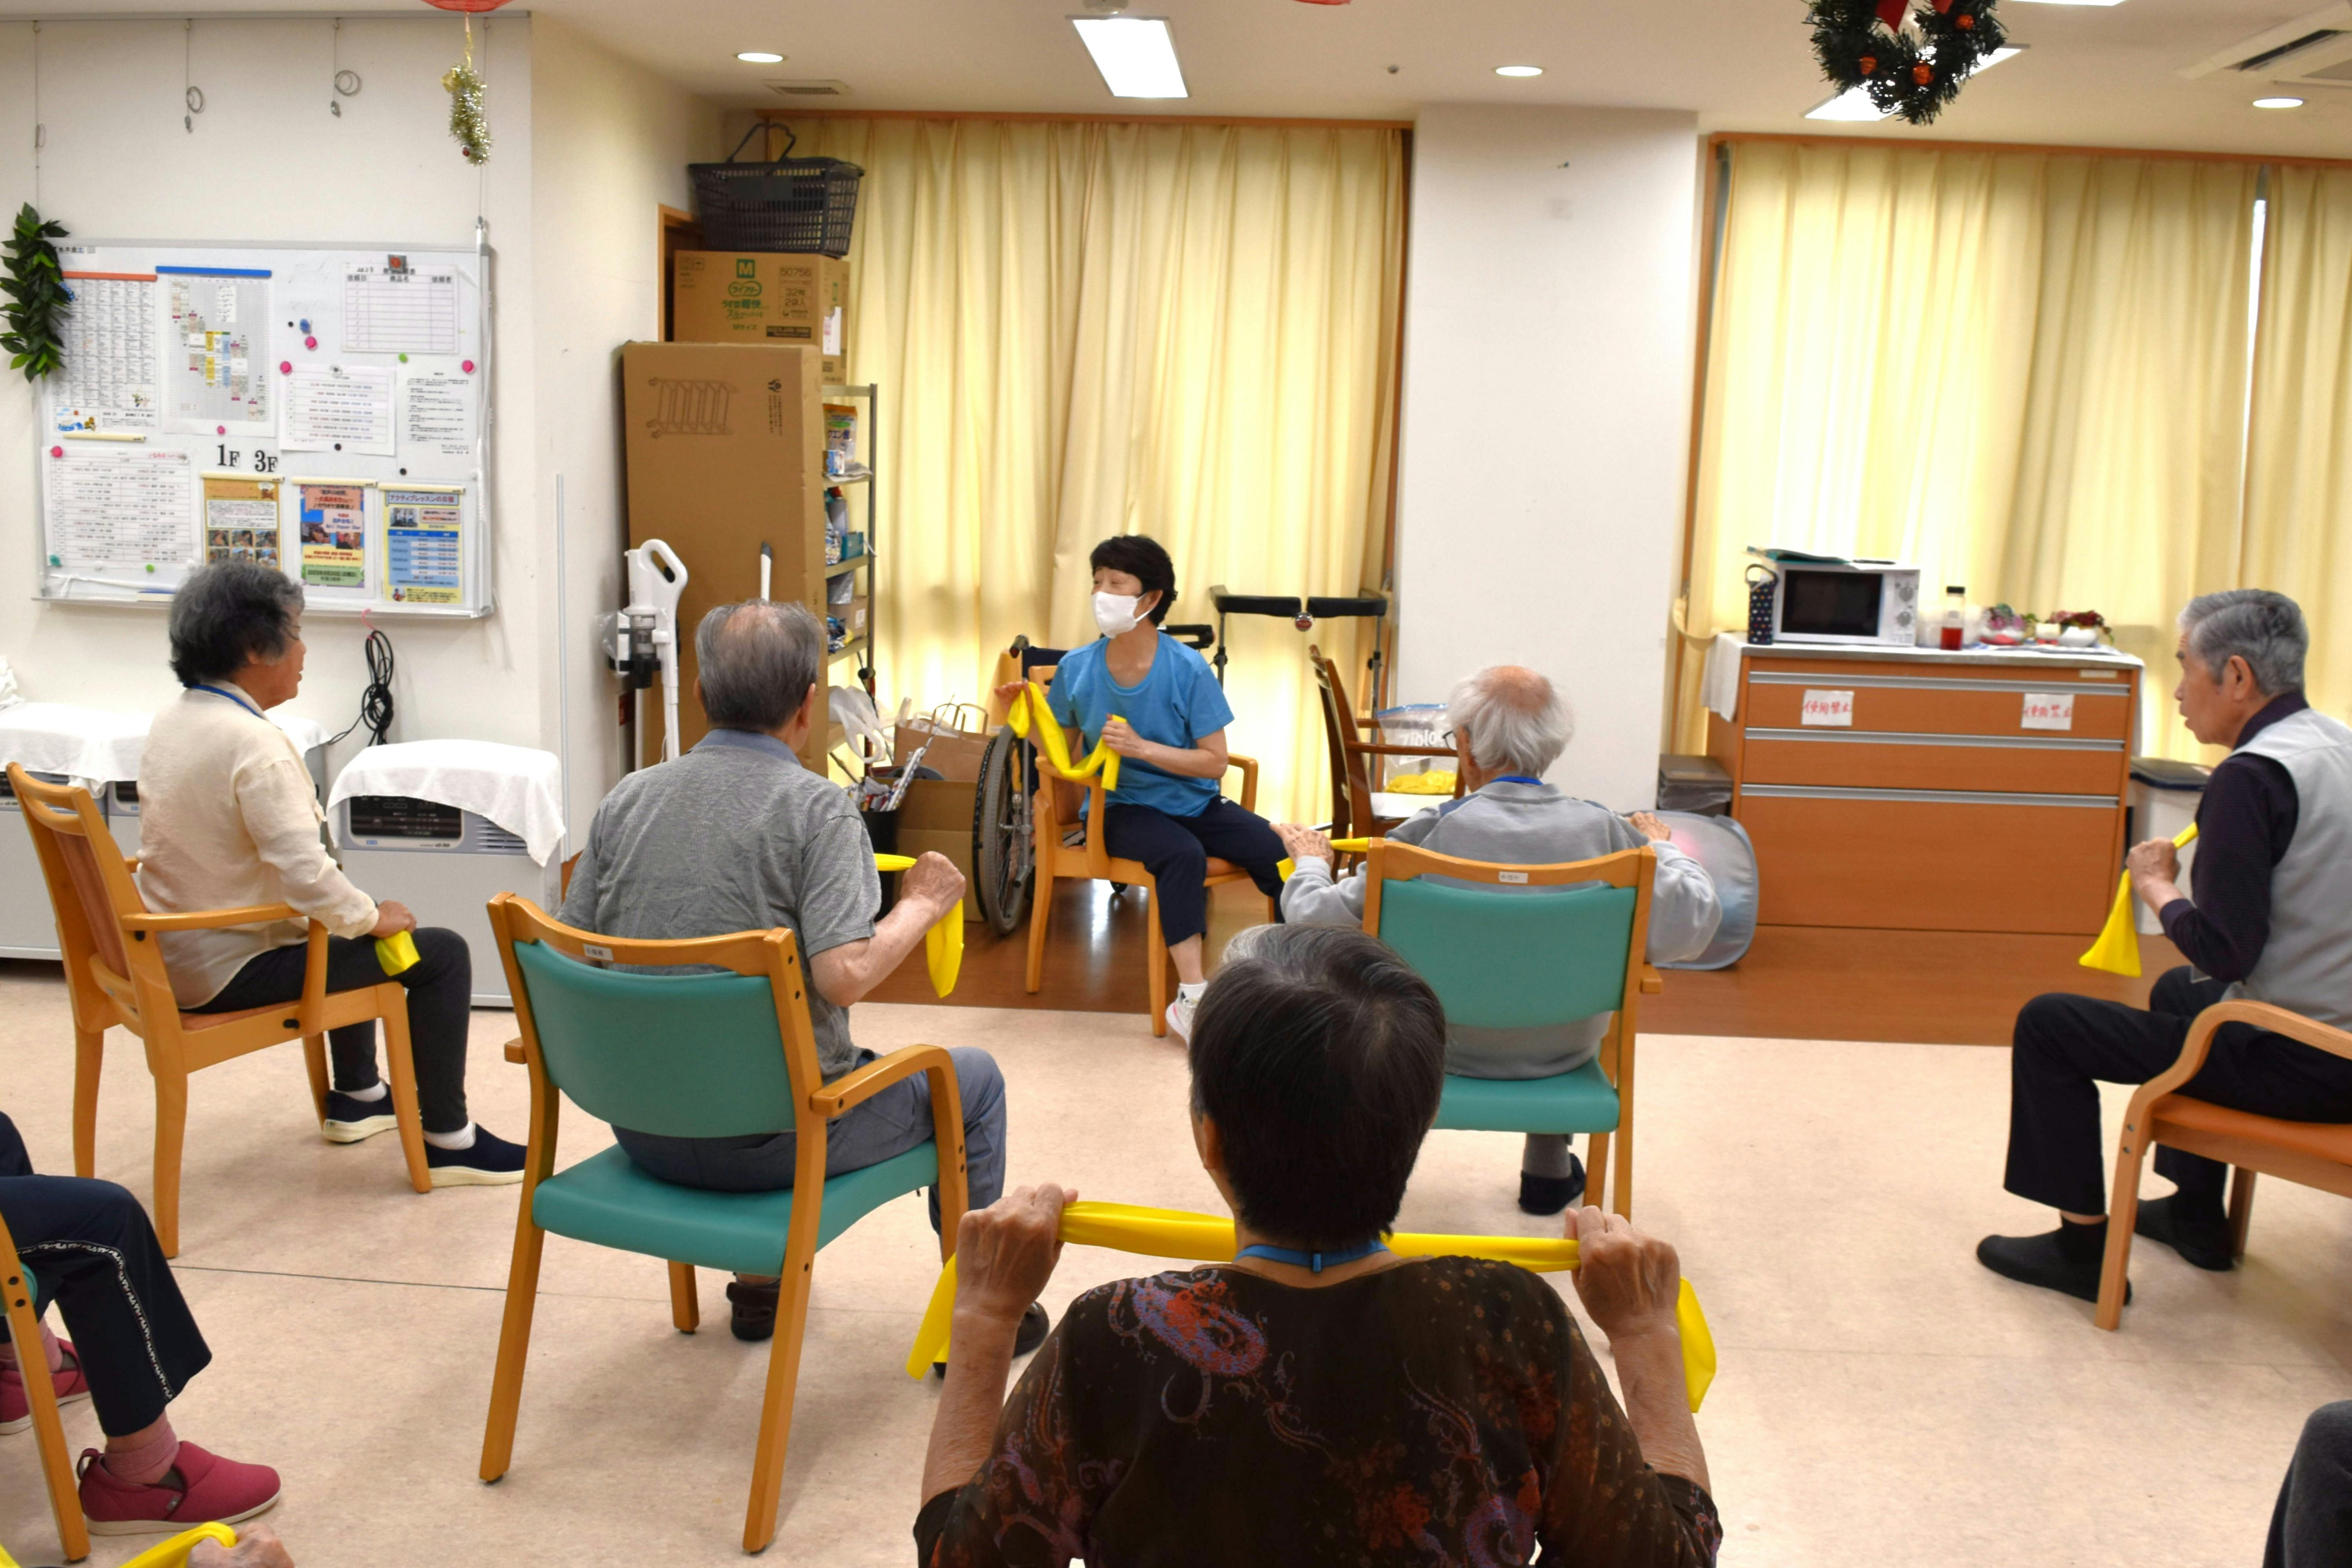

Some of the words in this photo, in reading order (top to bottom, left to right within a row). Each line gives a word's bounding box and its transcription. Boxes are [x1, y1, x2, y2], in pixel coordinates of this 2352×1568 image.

[739, 262, 753, 276] M
[780, 268, 811, 276] 50756
[217, 444, 240, 467] 1F
[255, 450, 278, 472] 3F
